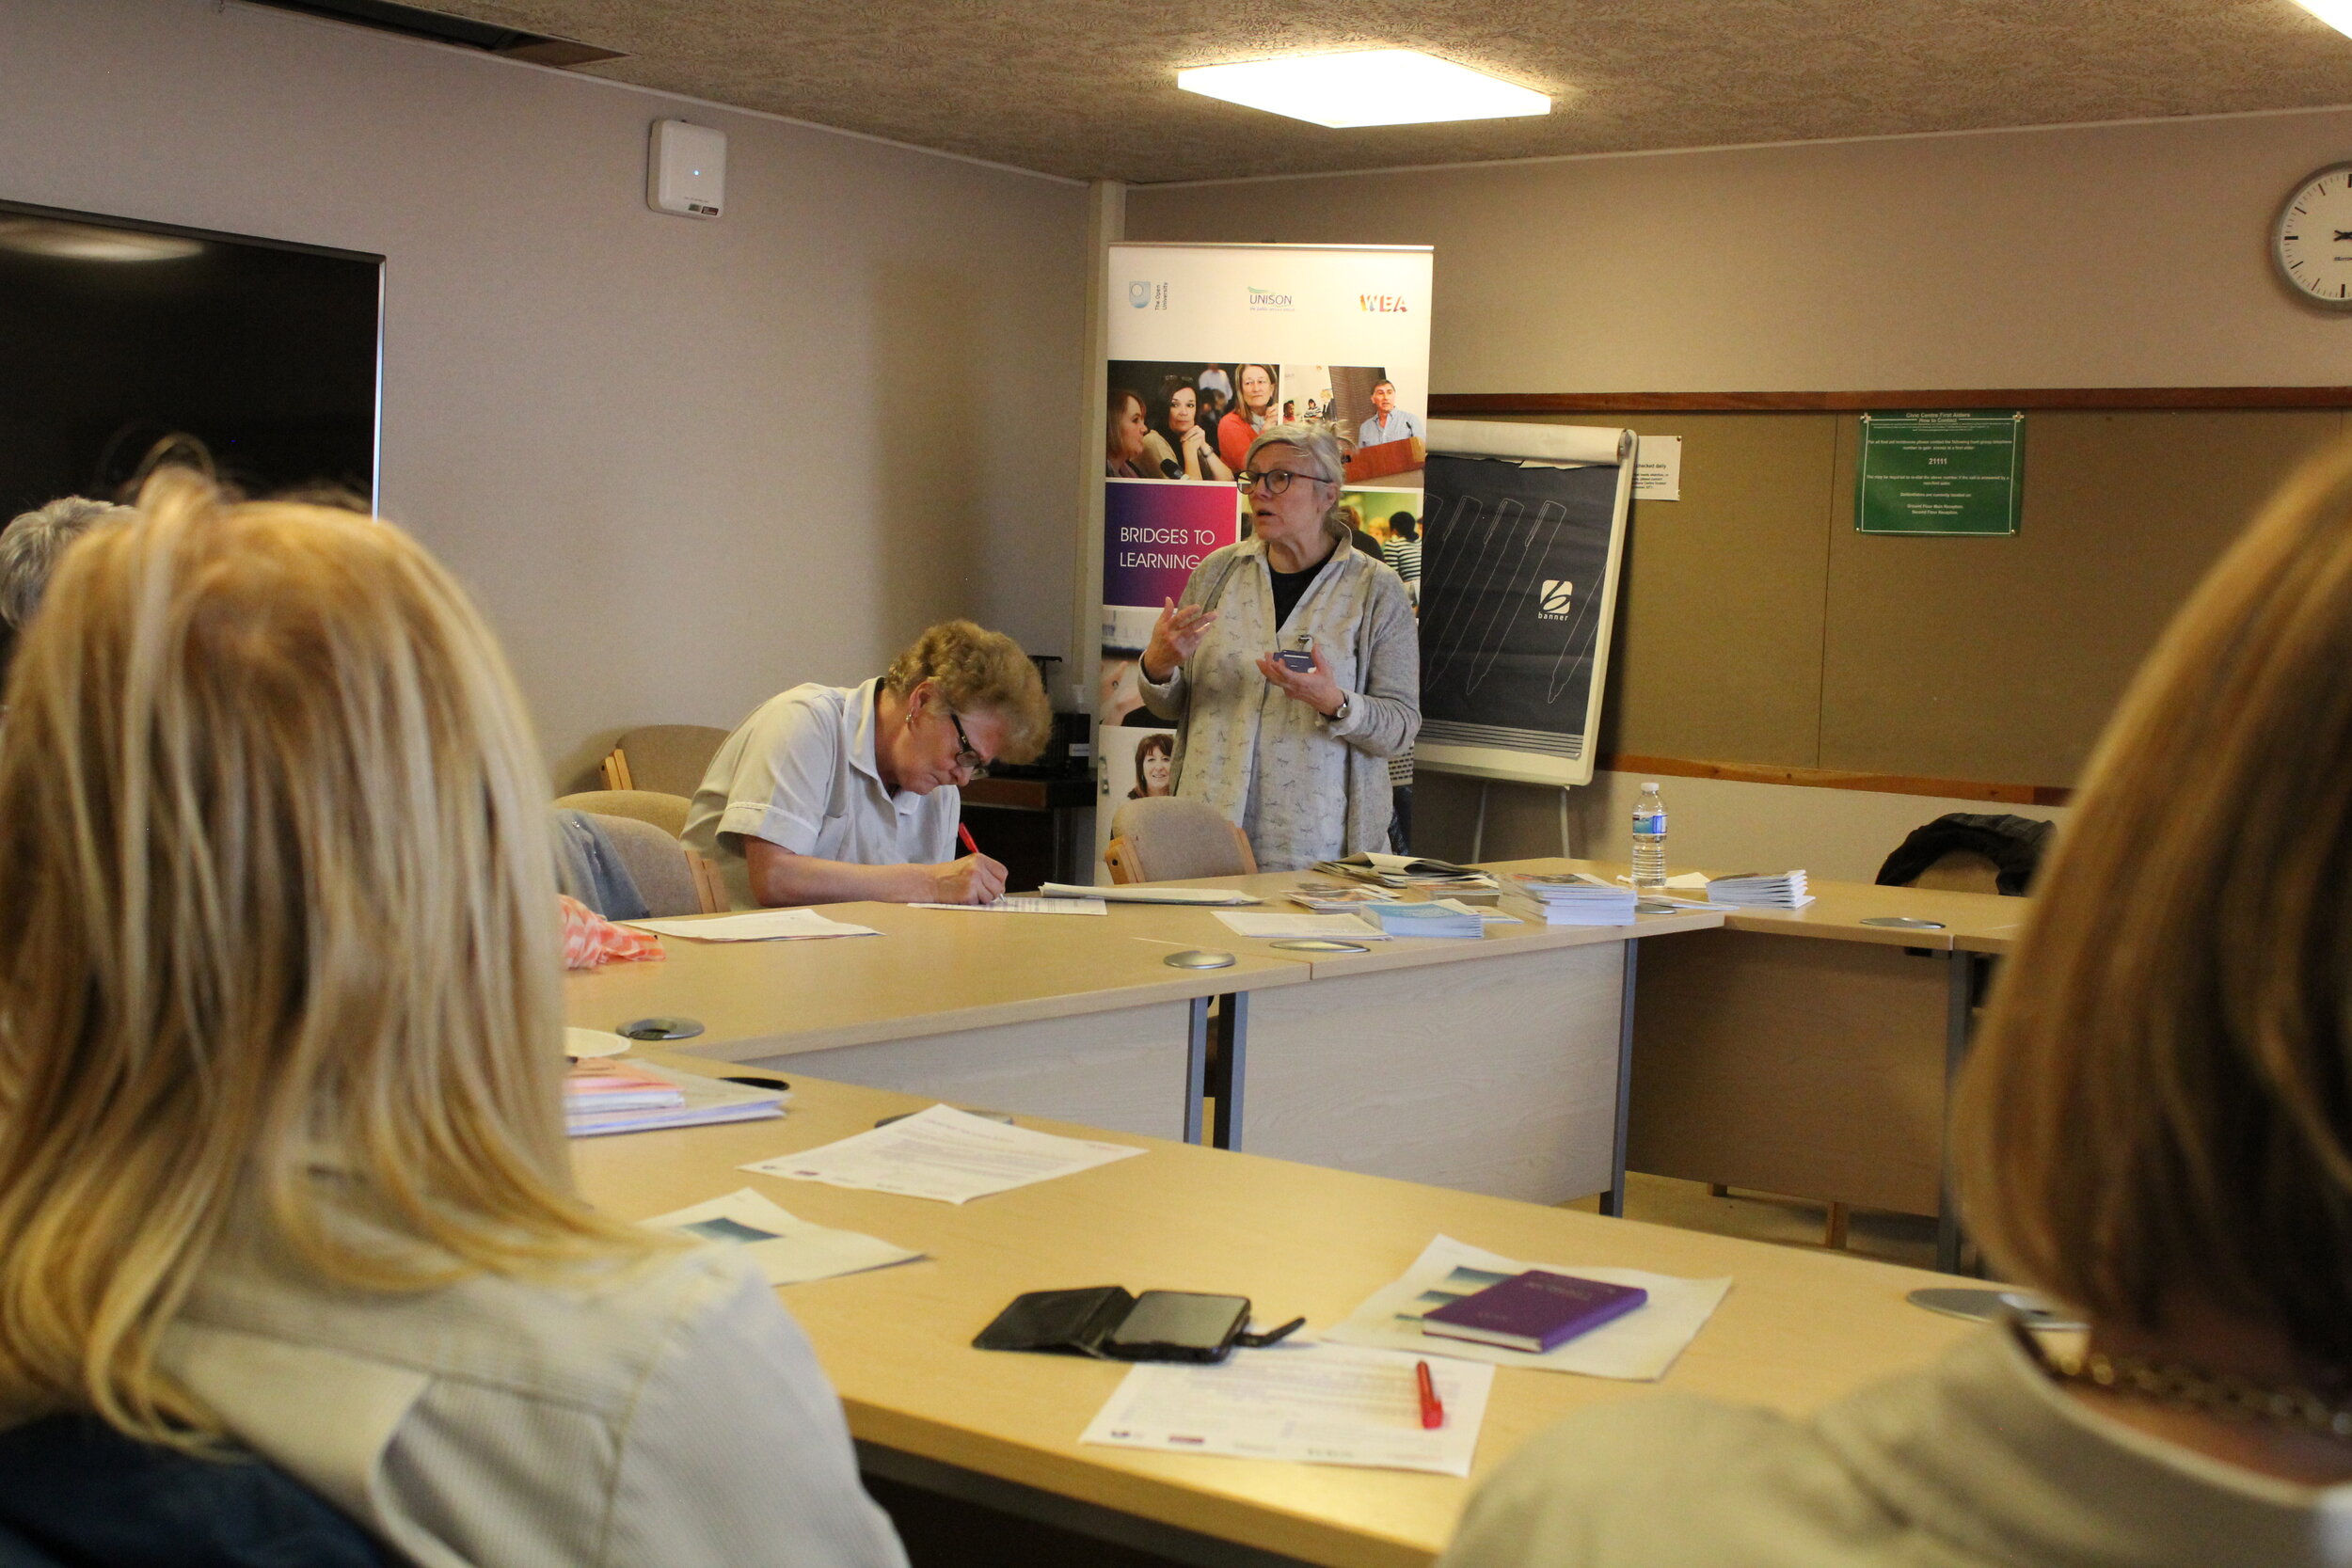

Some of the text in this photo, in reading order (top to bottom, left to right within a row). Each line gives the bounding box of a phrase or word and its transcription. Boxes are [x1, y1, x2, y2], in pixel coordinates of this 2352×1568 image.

[1249, 294, 1292, 305] UNISON
[1359, 293, 1407, 312] WEA
[1120, 527, 1216, 546] BRIDGES TO
[1120, 552, 1201, 570] LEARNING
[1537, 612, 1568, 622] banner
